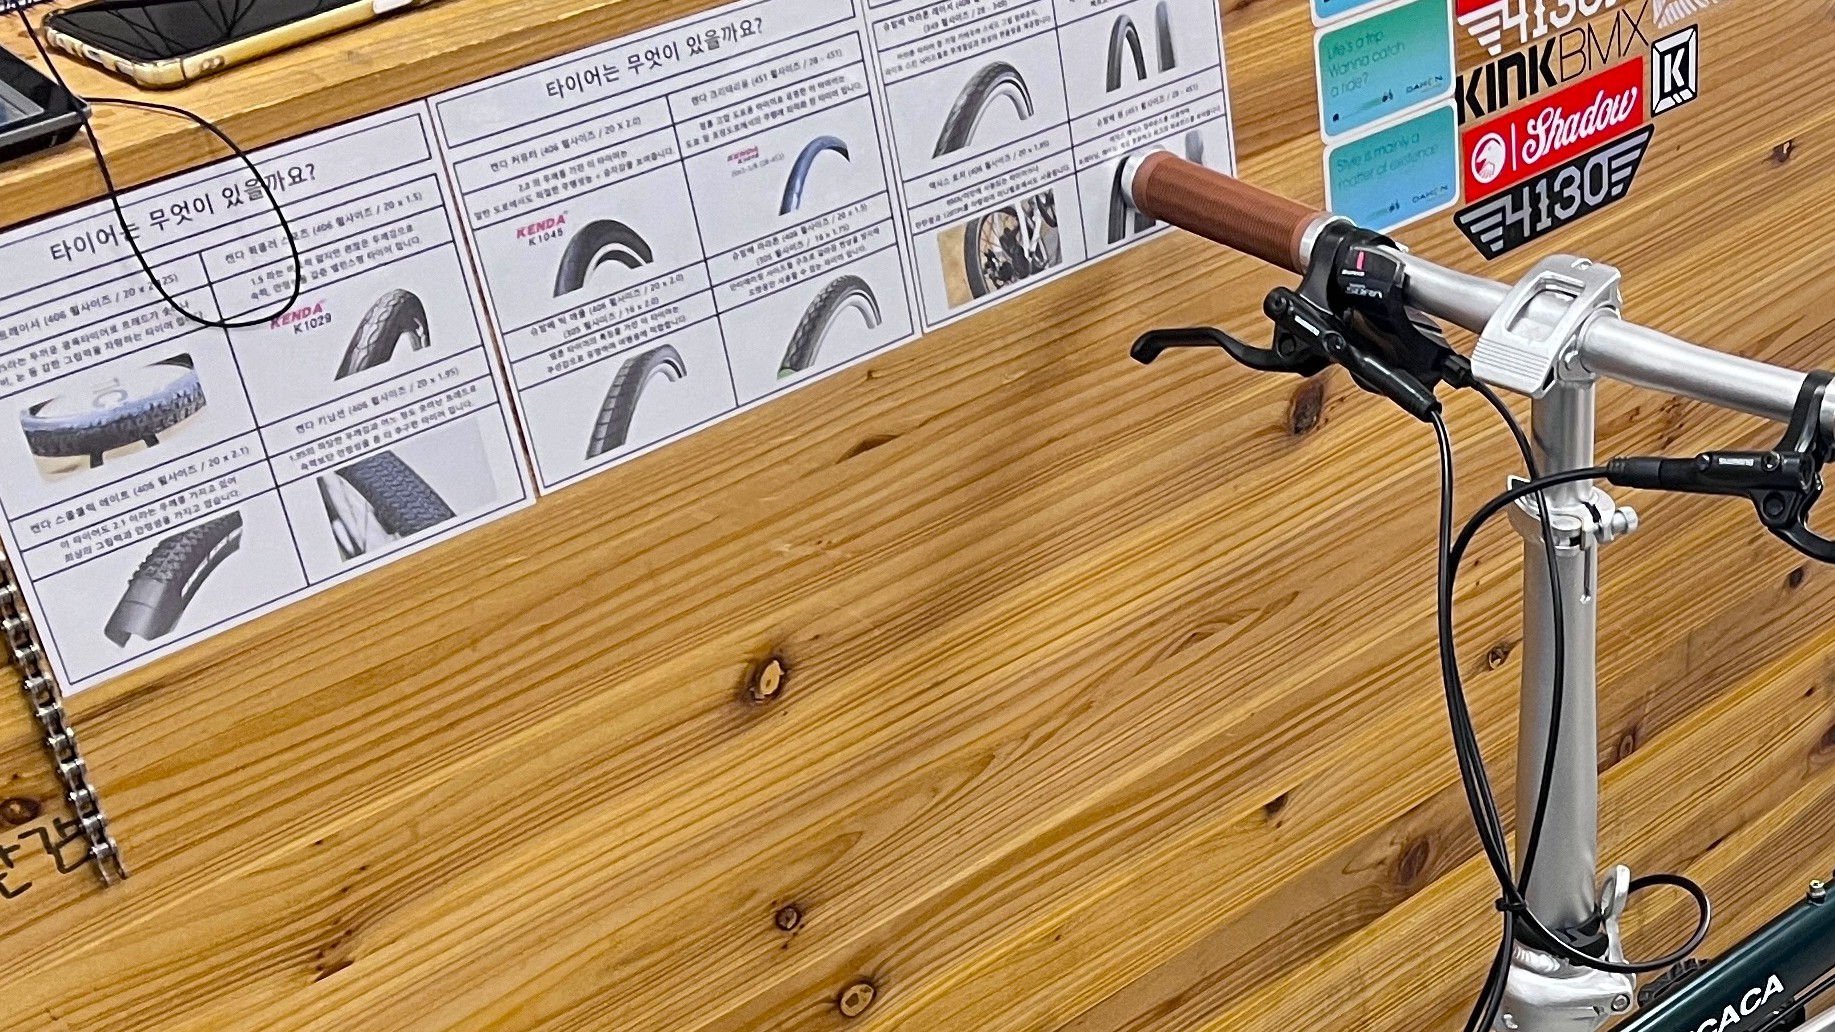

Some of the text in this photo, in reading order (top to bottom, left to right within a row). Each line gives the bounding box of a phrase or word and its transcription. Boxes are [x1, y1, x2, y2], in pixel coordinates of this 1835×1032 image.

[546, 17, 763, 99] 타이어는 무엇이 있을까요?
[604, 124, 616, 135] 20
[1522, 86, 1638, 165] Shadow
[1505, 153, 1609, 238] 4130
[50, 163, 315, 261] 타이어는 무엇이 있을까요?
[515, 213, 567, 239] KENDA
[269, 301, 325, 330] KENDA
[293, 312, 333, 335] K1029
[416, 378, 428, 389] 20
[207, 456, 221, 468] 20
